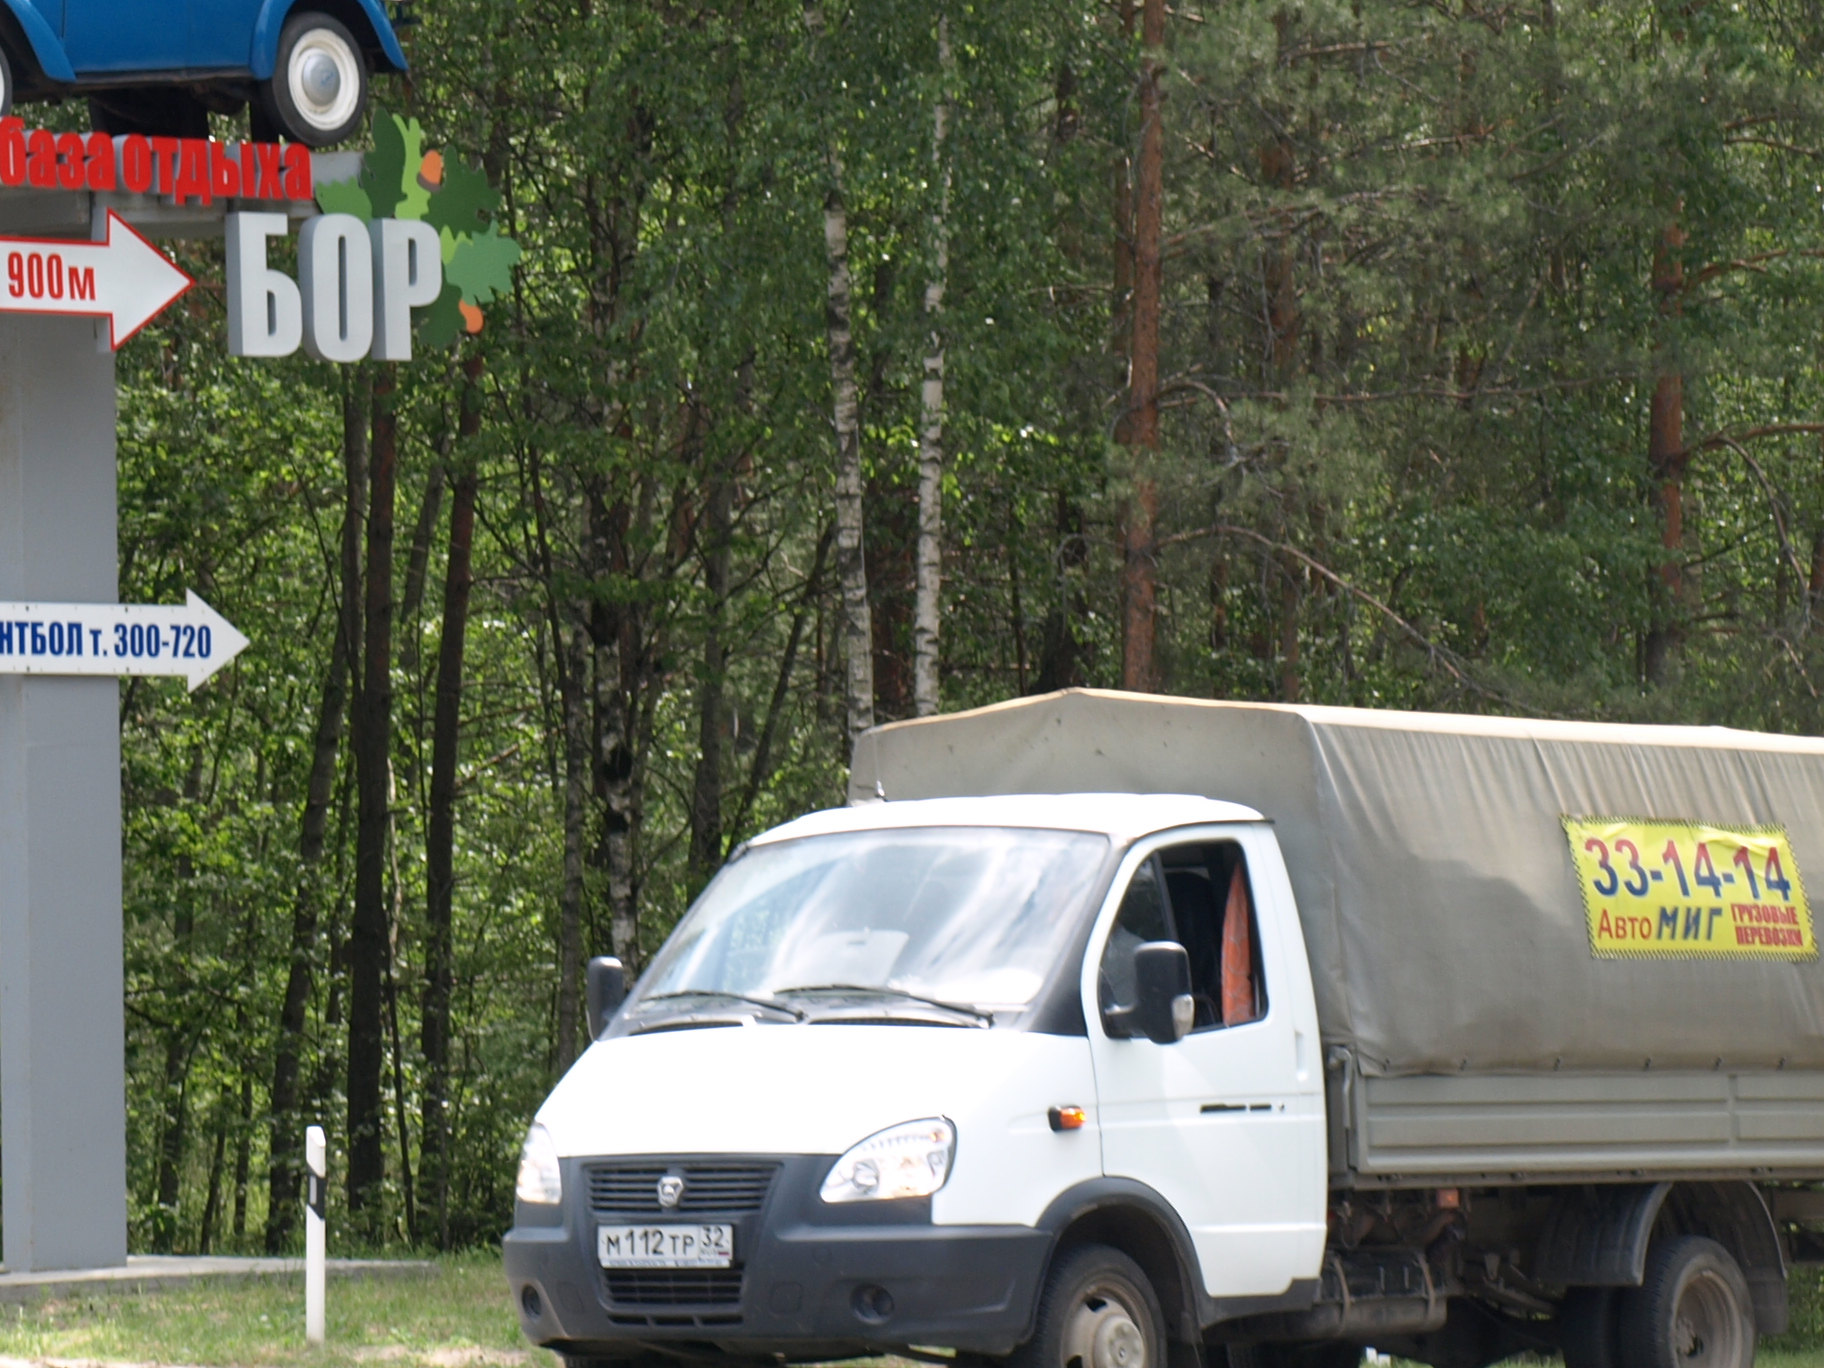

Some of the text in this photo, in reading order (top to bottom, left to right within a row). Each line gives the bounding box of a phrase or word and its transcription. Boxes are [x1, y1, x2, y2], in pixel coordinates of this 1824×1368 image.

[122, 133, 314, 206] отдыха
[234, 211, 443, 363] БОР
[1584, 837, 1792, 902] 33-14-14
[1730, 903, 1800, 925] ГРУЗОВЫЕ
[1735, 926, 1804, 947] ПЕРЕВОЗКИ
